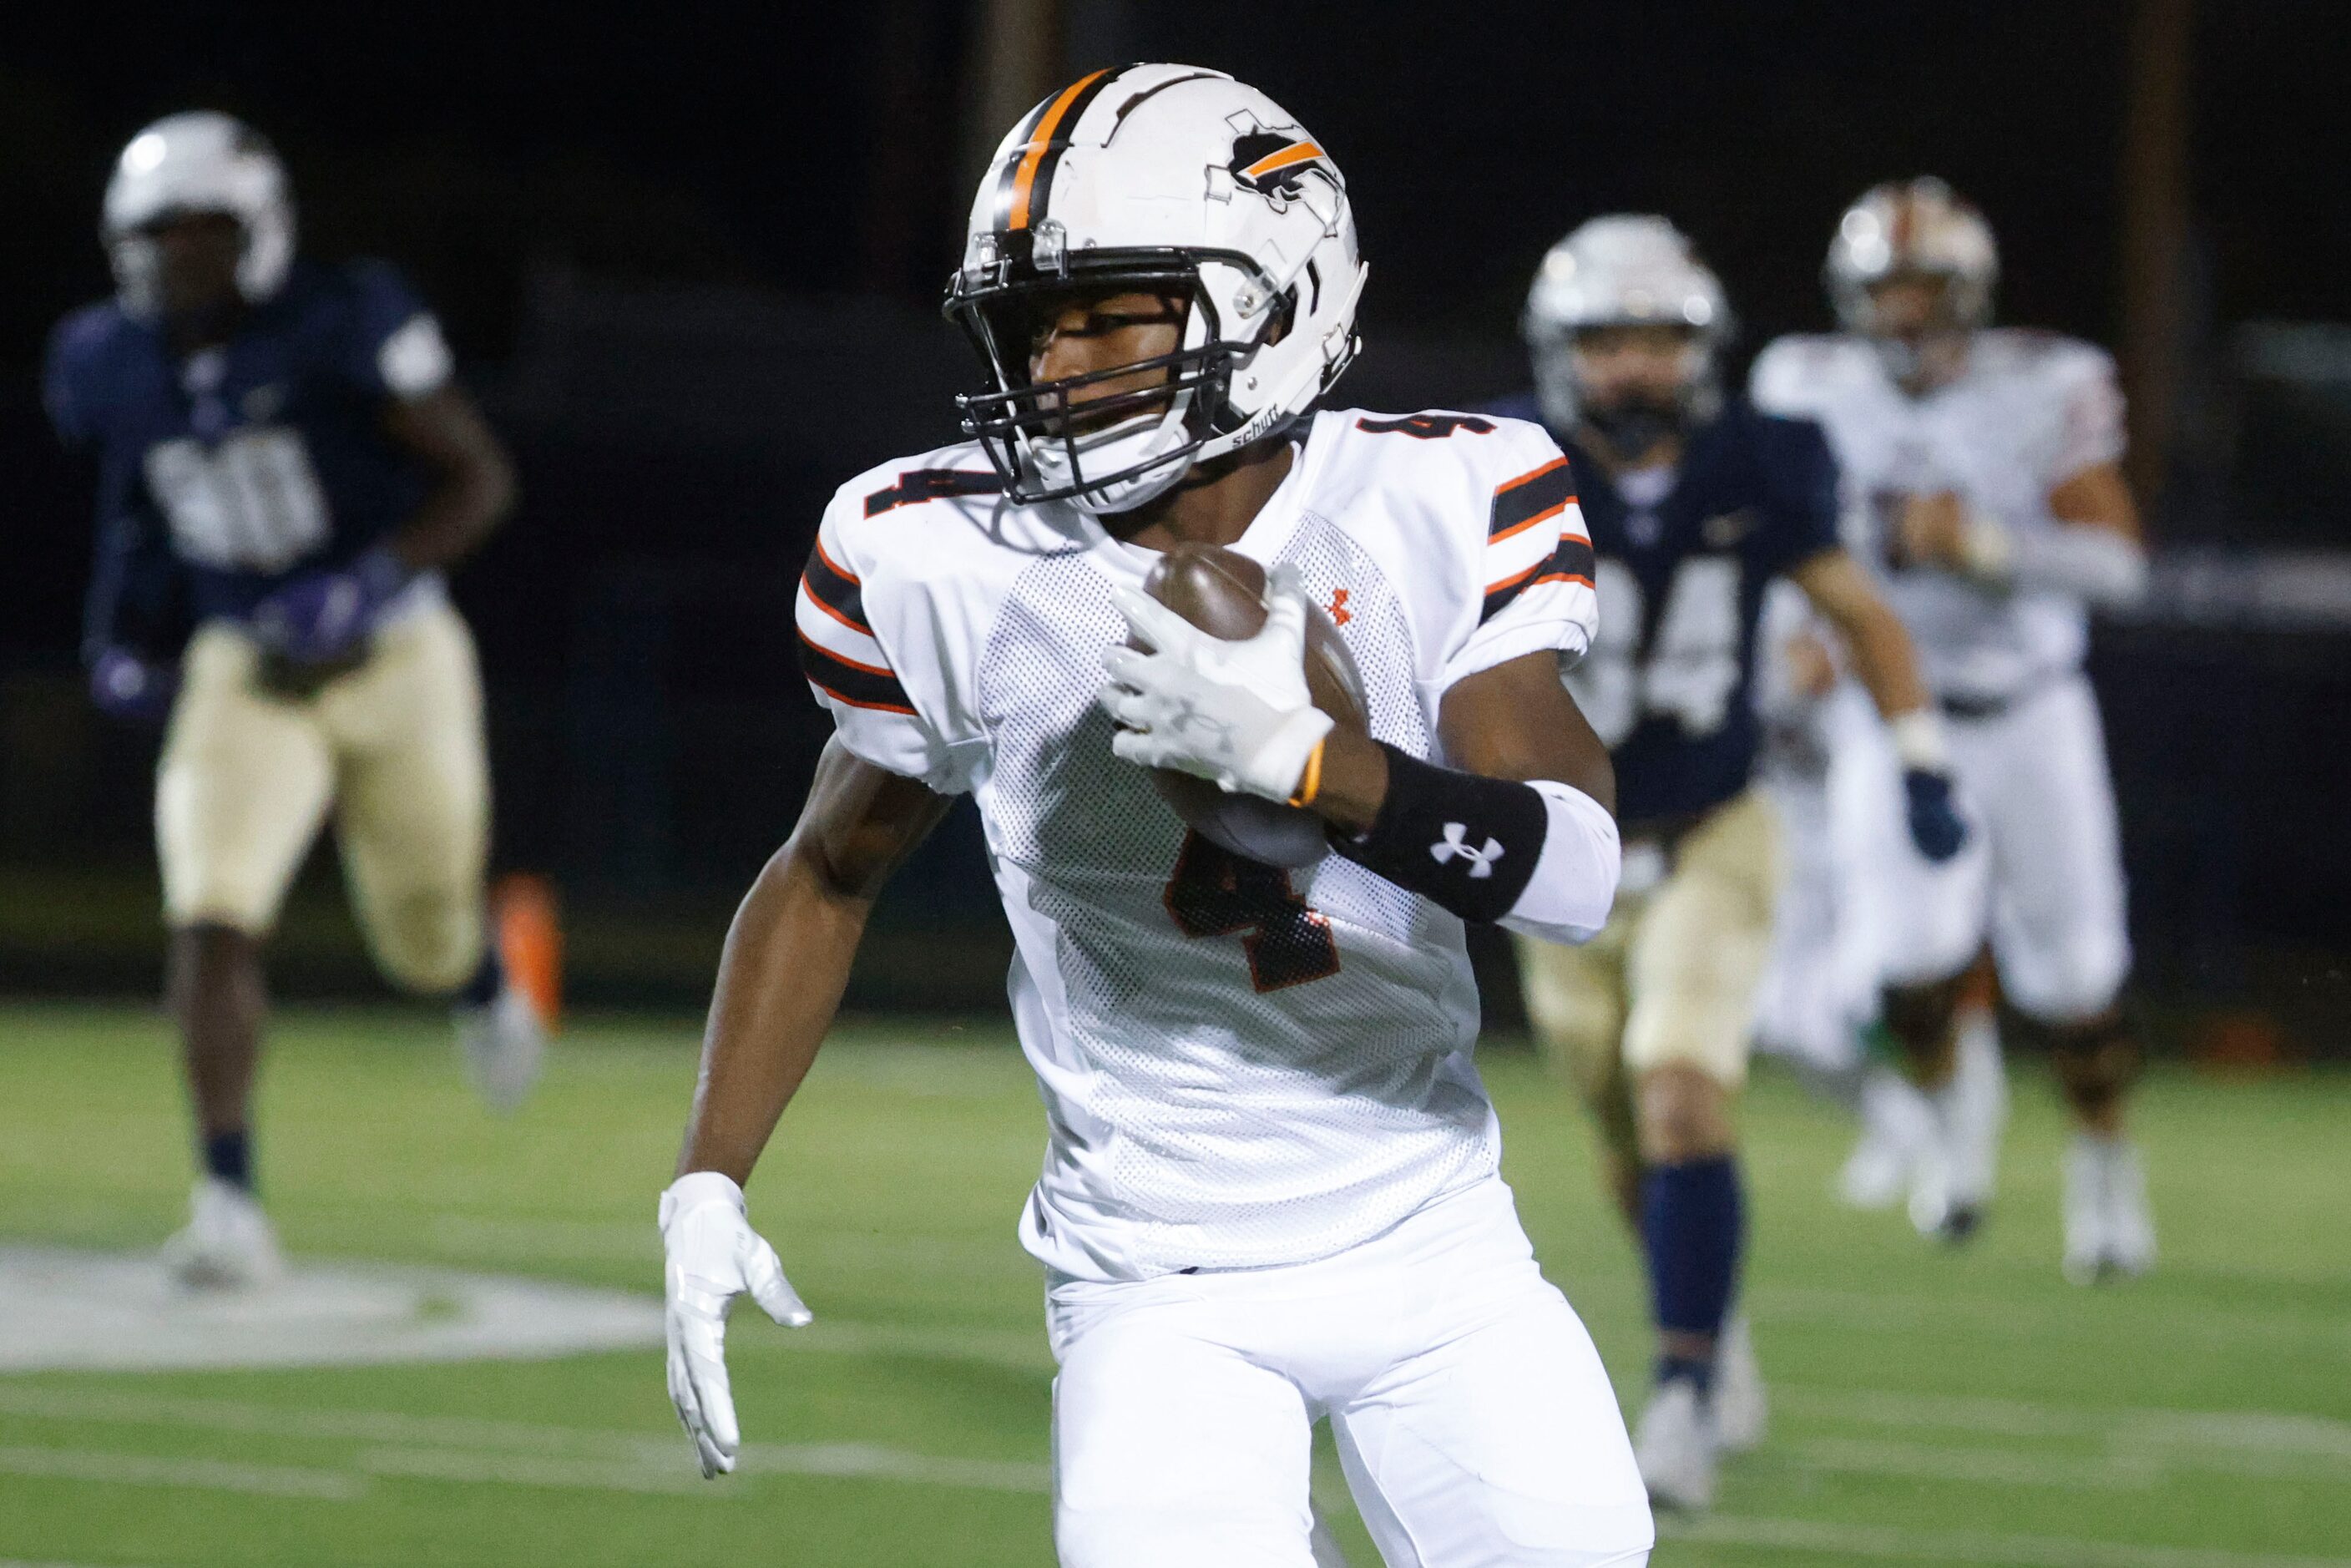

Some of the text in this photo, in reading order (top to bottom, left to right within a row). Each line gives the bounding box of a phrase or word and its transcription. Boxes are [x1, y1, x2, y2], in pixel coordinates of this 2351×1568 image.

[1232, 402, 1277, 448] schutt
[863, 468, 1004, 520] 4
[1163, 827, 1341, 993] 4
